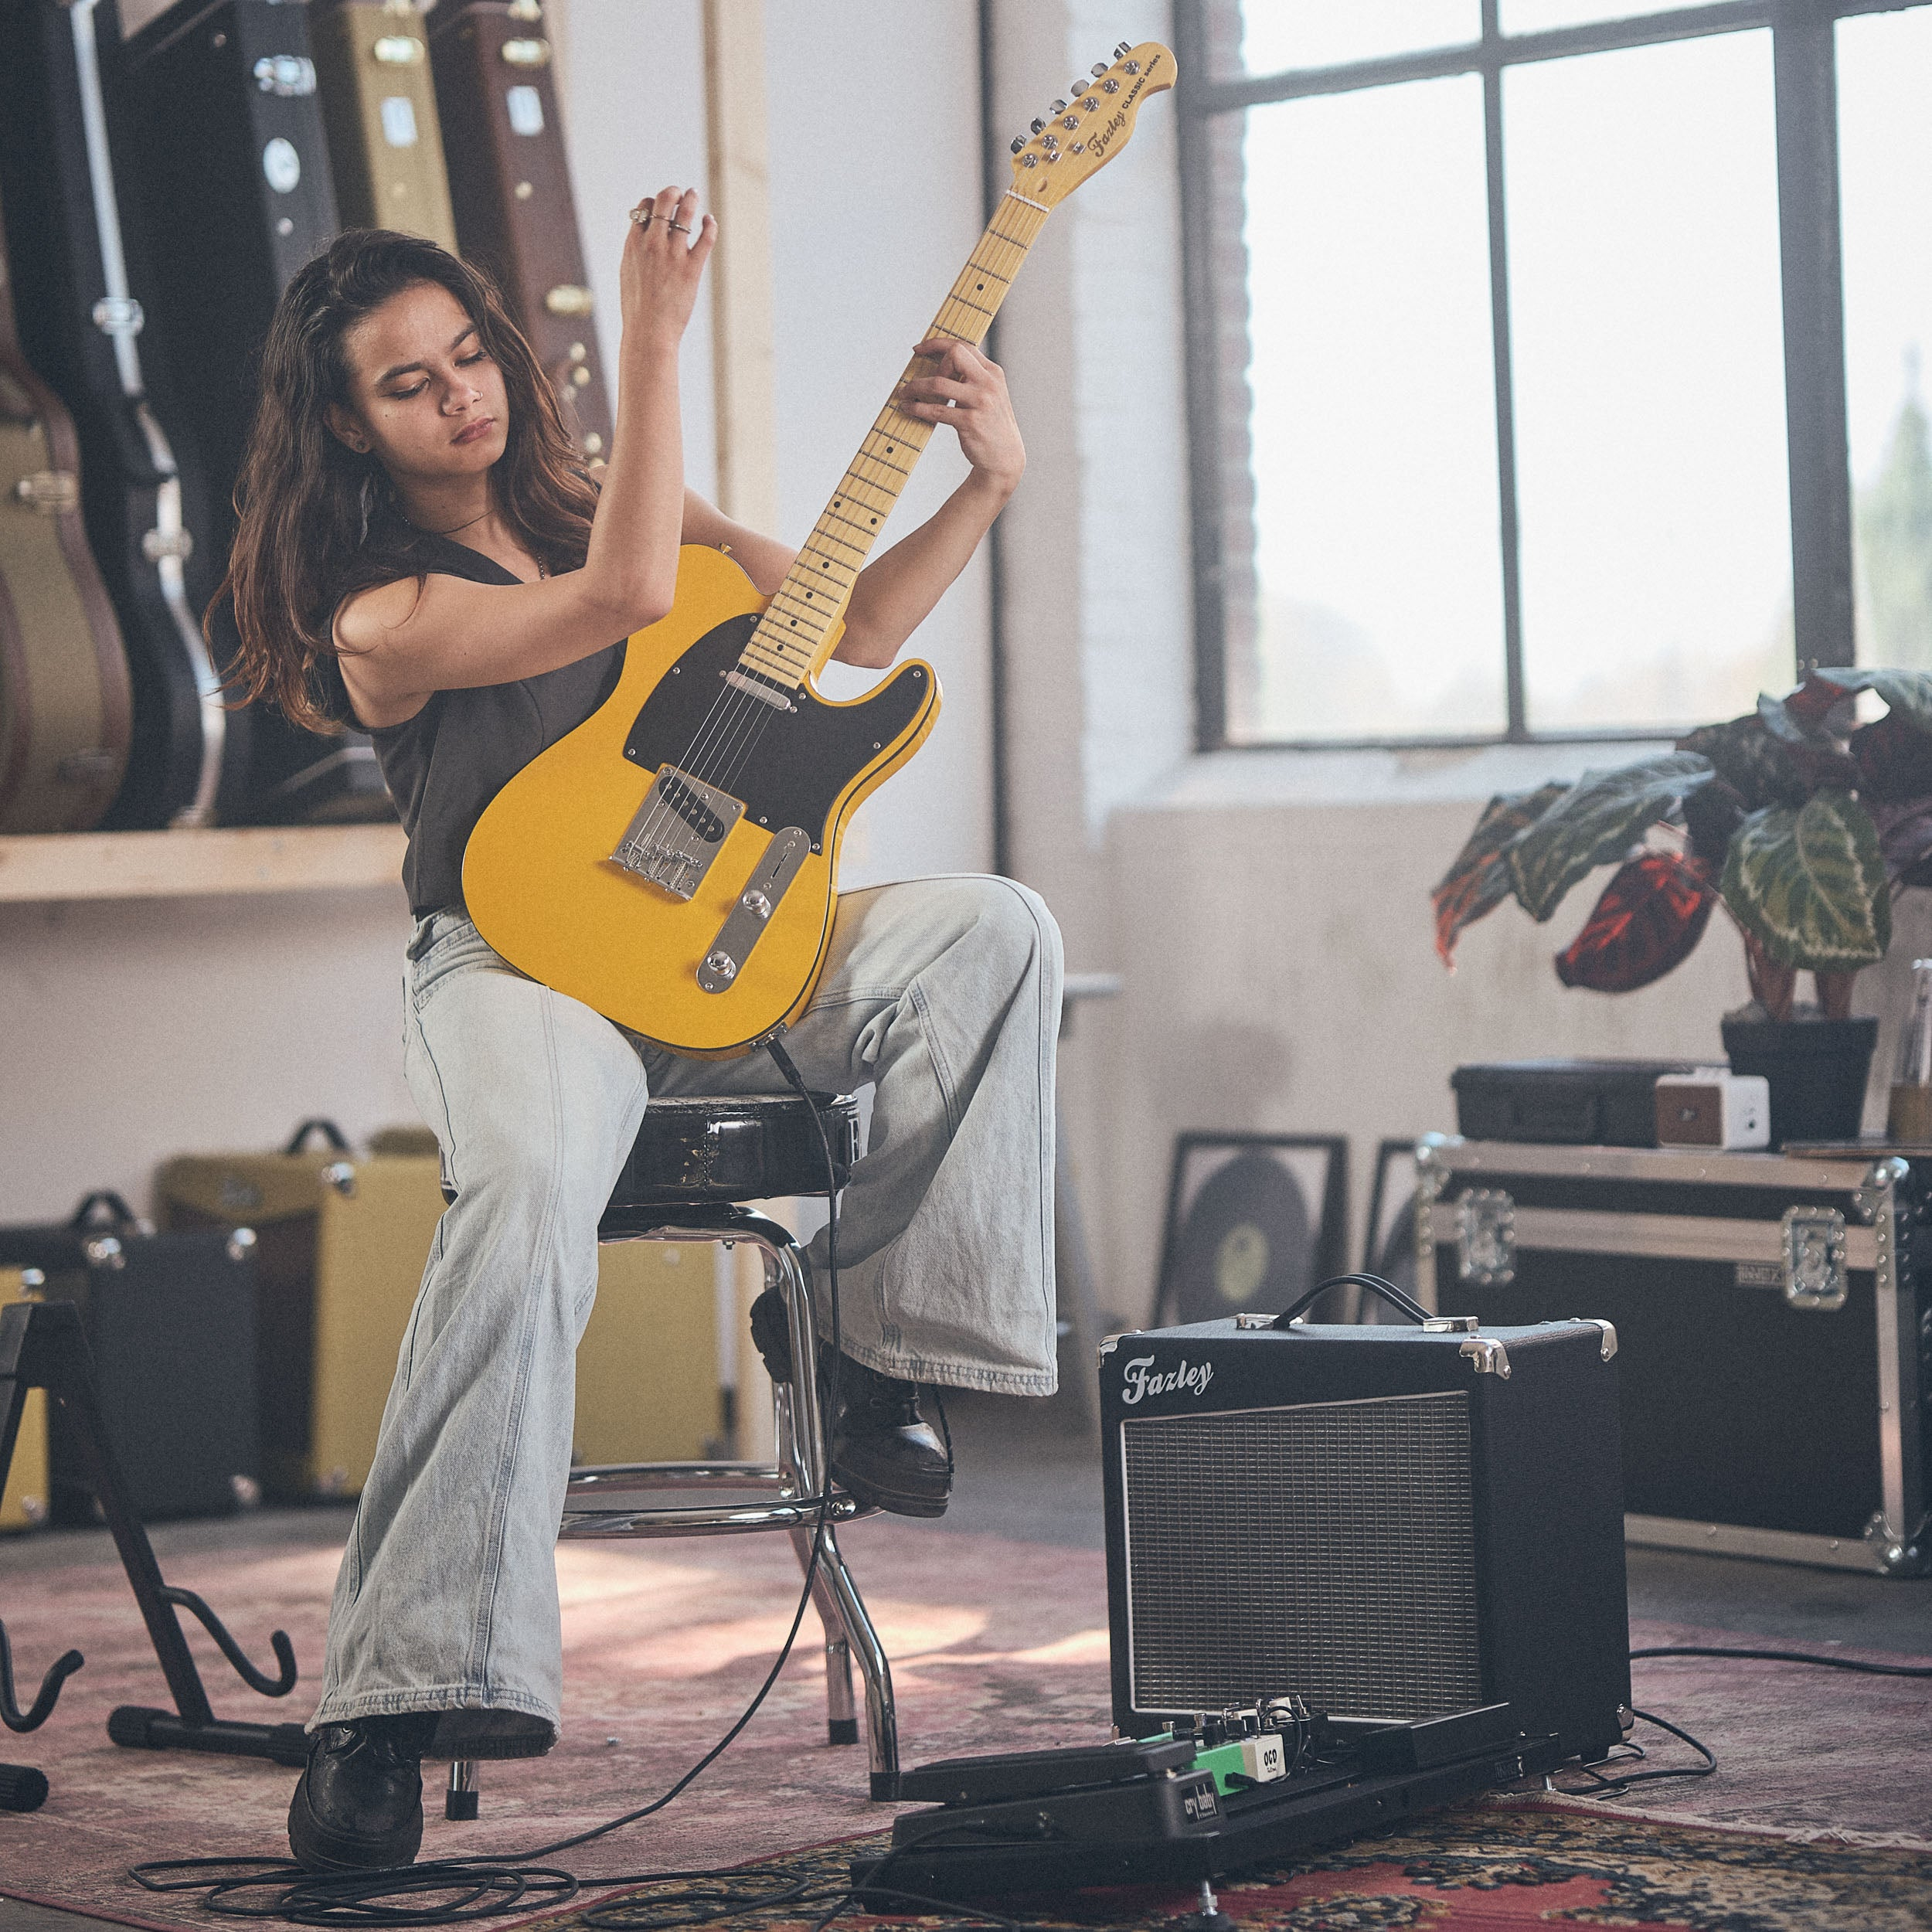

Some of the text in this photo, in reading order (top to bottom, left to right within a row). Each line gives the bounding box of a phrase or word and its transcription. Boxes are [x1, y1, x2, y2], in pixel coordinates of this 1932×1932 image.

[1087, 53, 1162, 158] Fazley CLASSIC series
[1122, 1354, 1214, 1404] Fazley
[1184, 1783, 1217, 1820] cry baby
